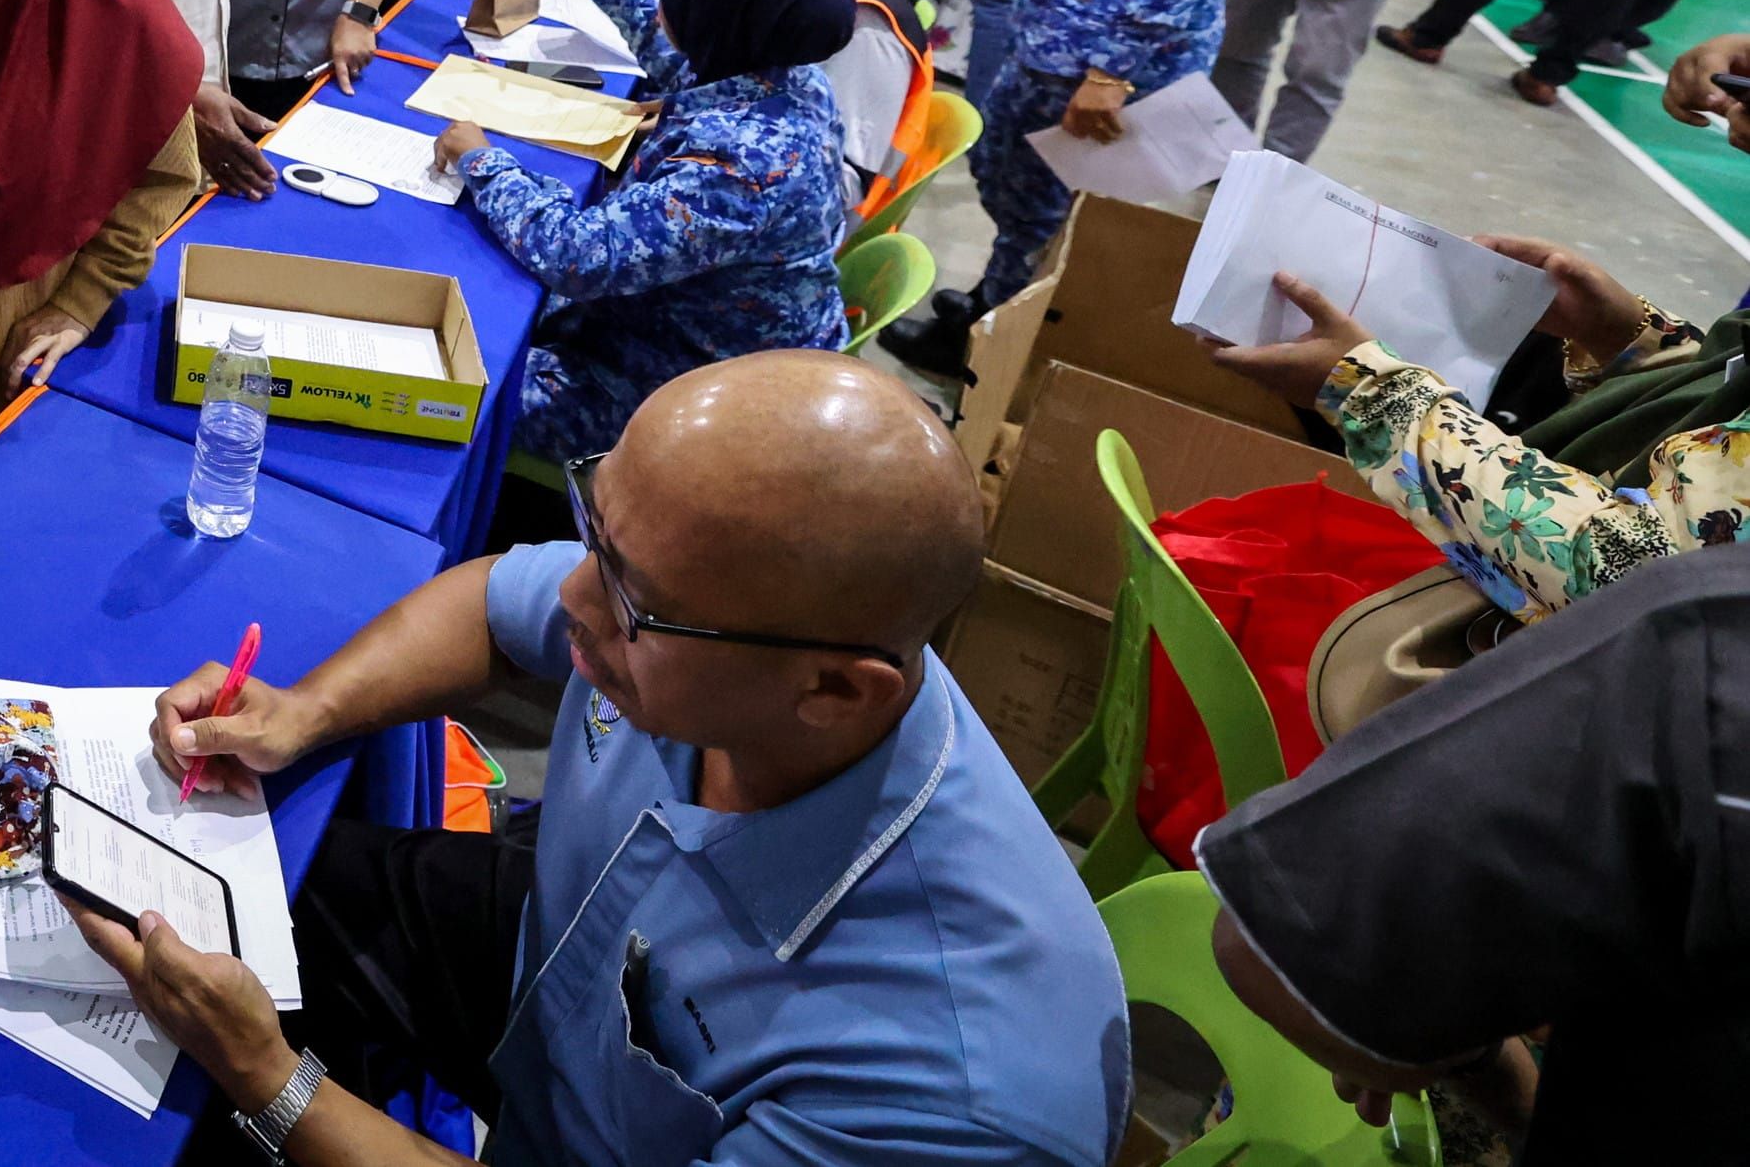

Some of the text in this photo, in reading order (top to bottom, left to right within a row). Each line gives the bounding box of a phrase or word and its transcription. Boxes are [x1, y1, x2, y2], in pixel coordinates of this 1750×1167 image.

[301, 387, 352, 400] YELLOW
[82, 994, 100, 1024] Tandatanga
[684, 997, 716, 1054] BASRI
